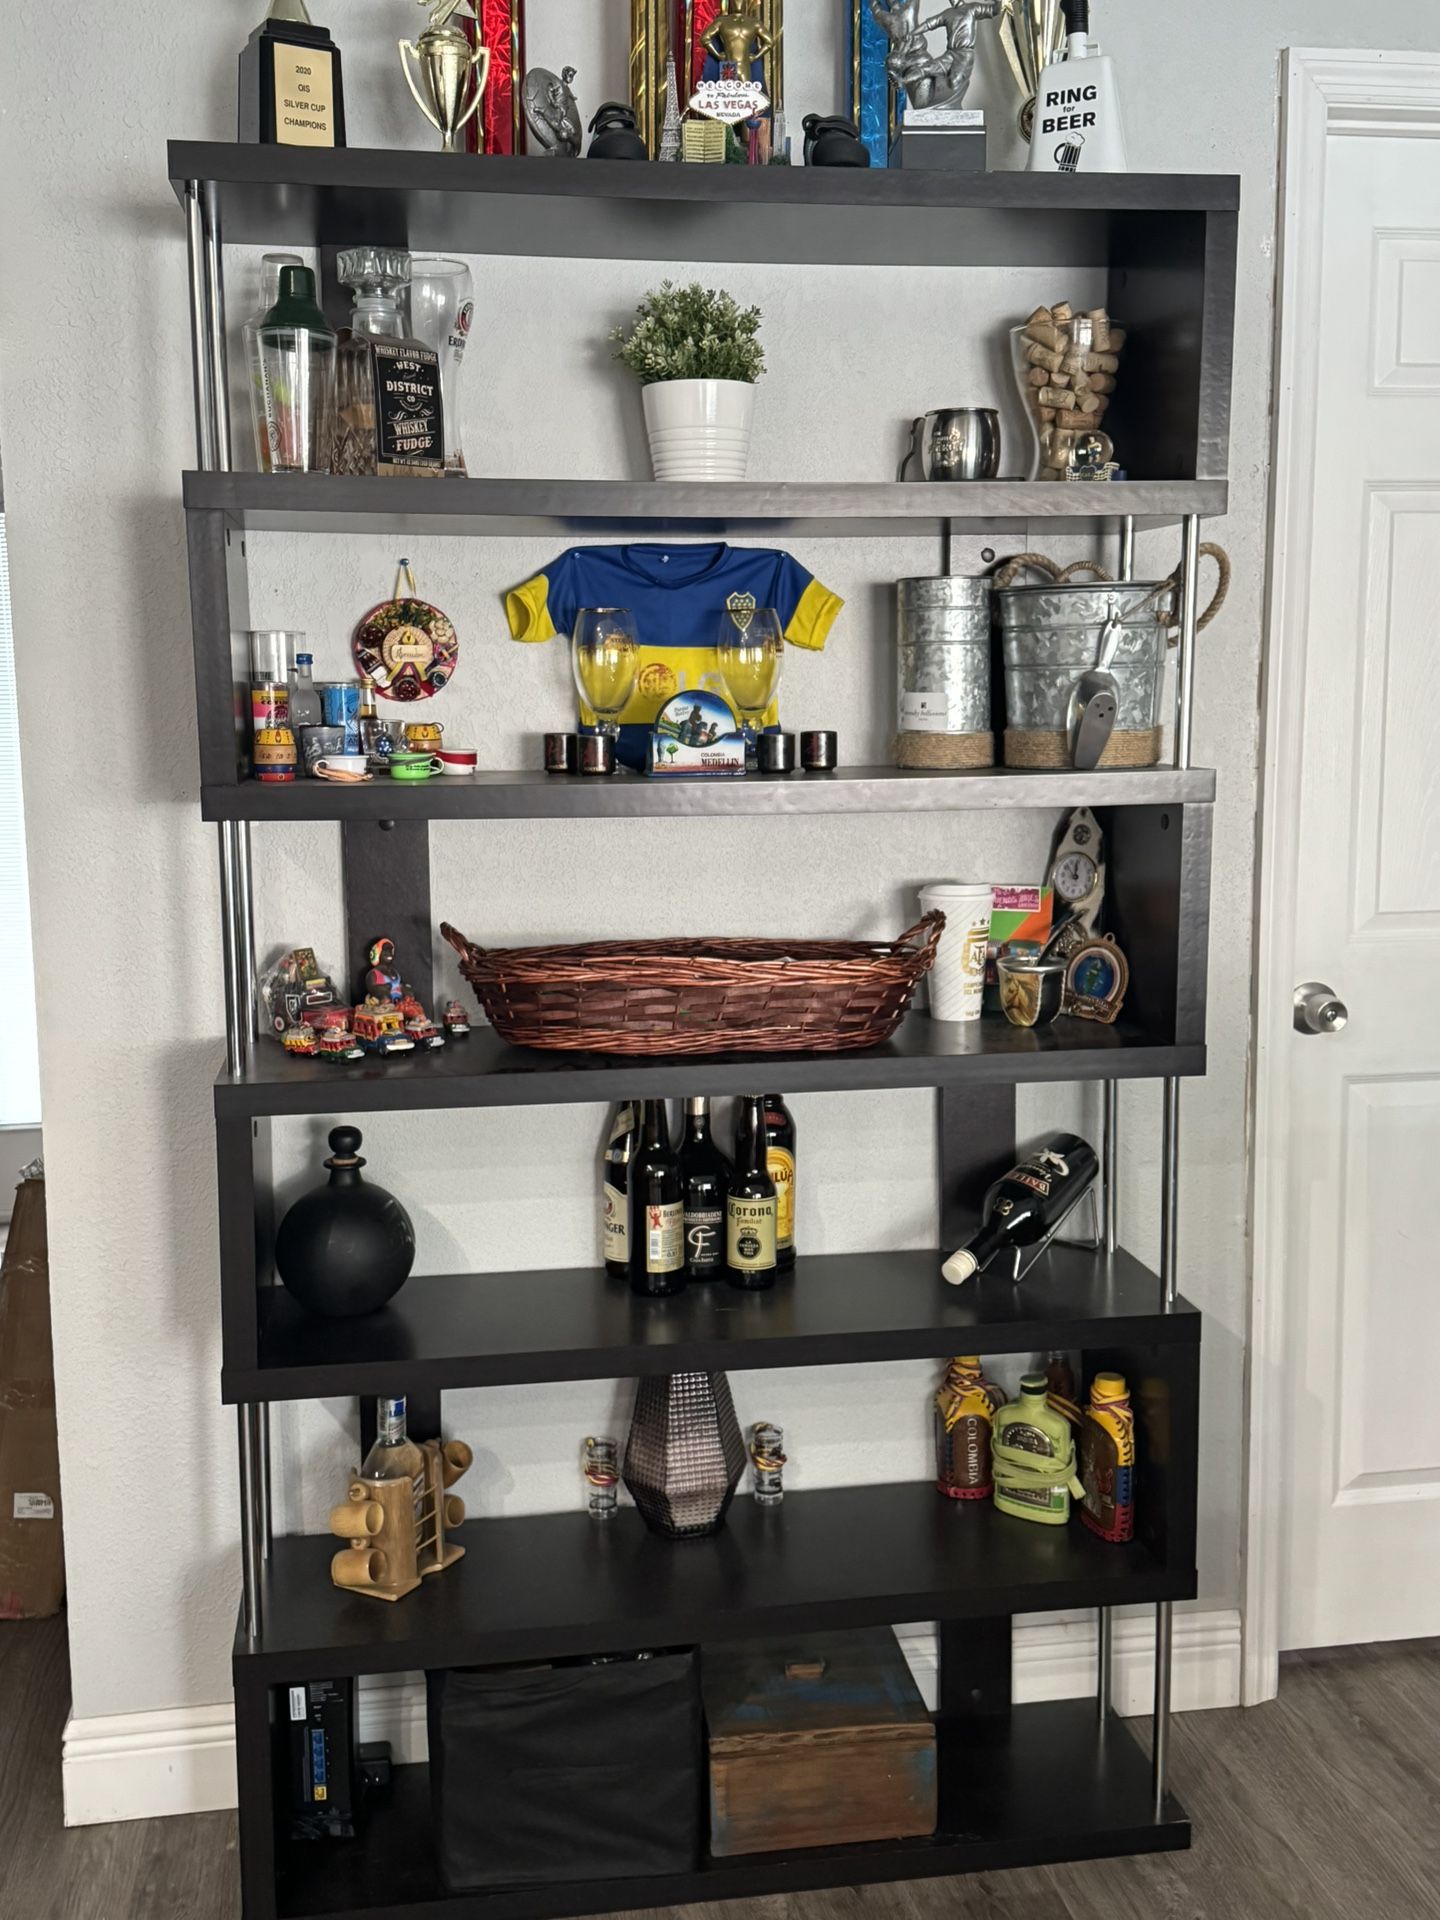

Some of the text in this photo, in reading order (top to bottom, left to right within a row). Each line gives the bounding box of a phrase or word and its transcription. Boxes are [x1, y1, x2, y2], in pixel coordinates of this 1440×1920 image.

[296, 66, 312, 75] 2020
[298, 84, 310, 93] OIS
[697, 82, 761, 90] WELCOME
[1046, 85, 1096, 107] RING
[284, 99, 326, 112] SILVER CUP
[698, 100, 758, 110] LAS VEGAS
[284, 117, 326, 130] CHAMPIONS
[1042, 112, 1096, 134] BEER
[375, 344, 398, 356] WHISKEY
[396, 360, 421, 372] WEST
[386, 380, 434, 396] DISTRICT
[393, 420, 428, 436] WHISKEY
[396, 436, 432, 451] FUDGE
[728, 1202, 772, 1218] Corona
[968, 1418, 978, 1484] COLOMBIA
